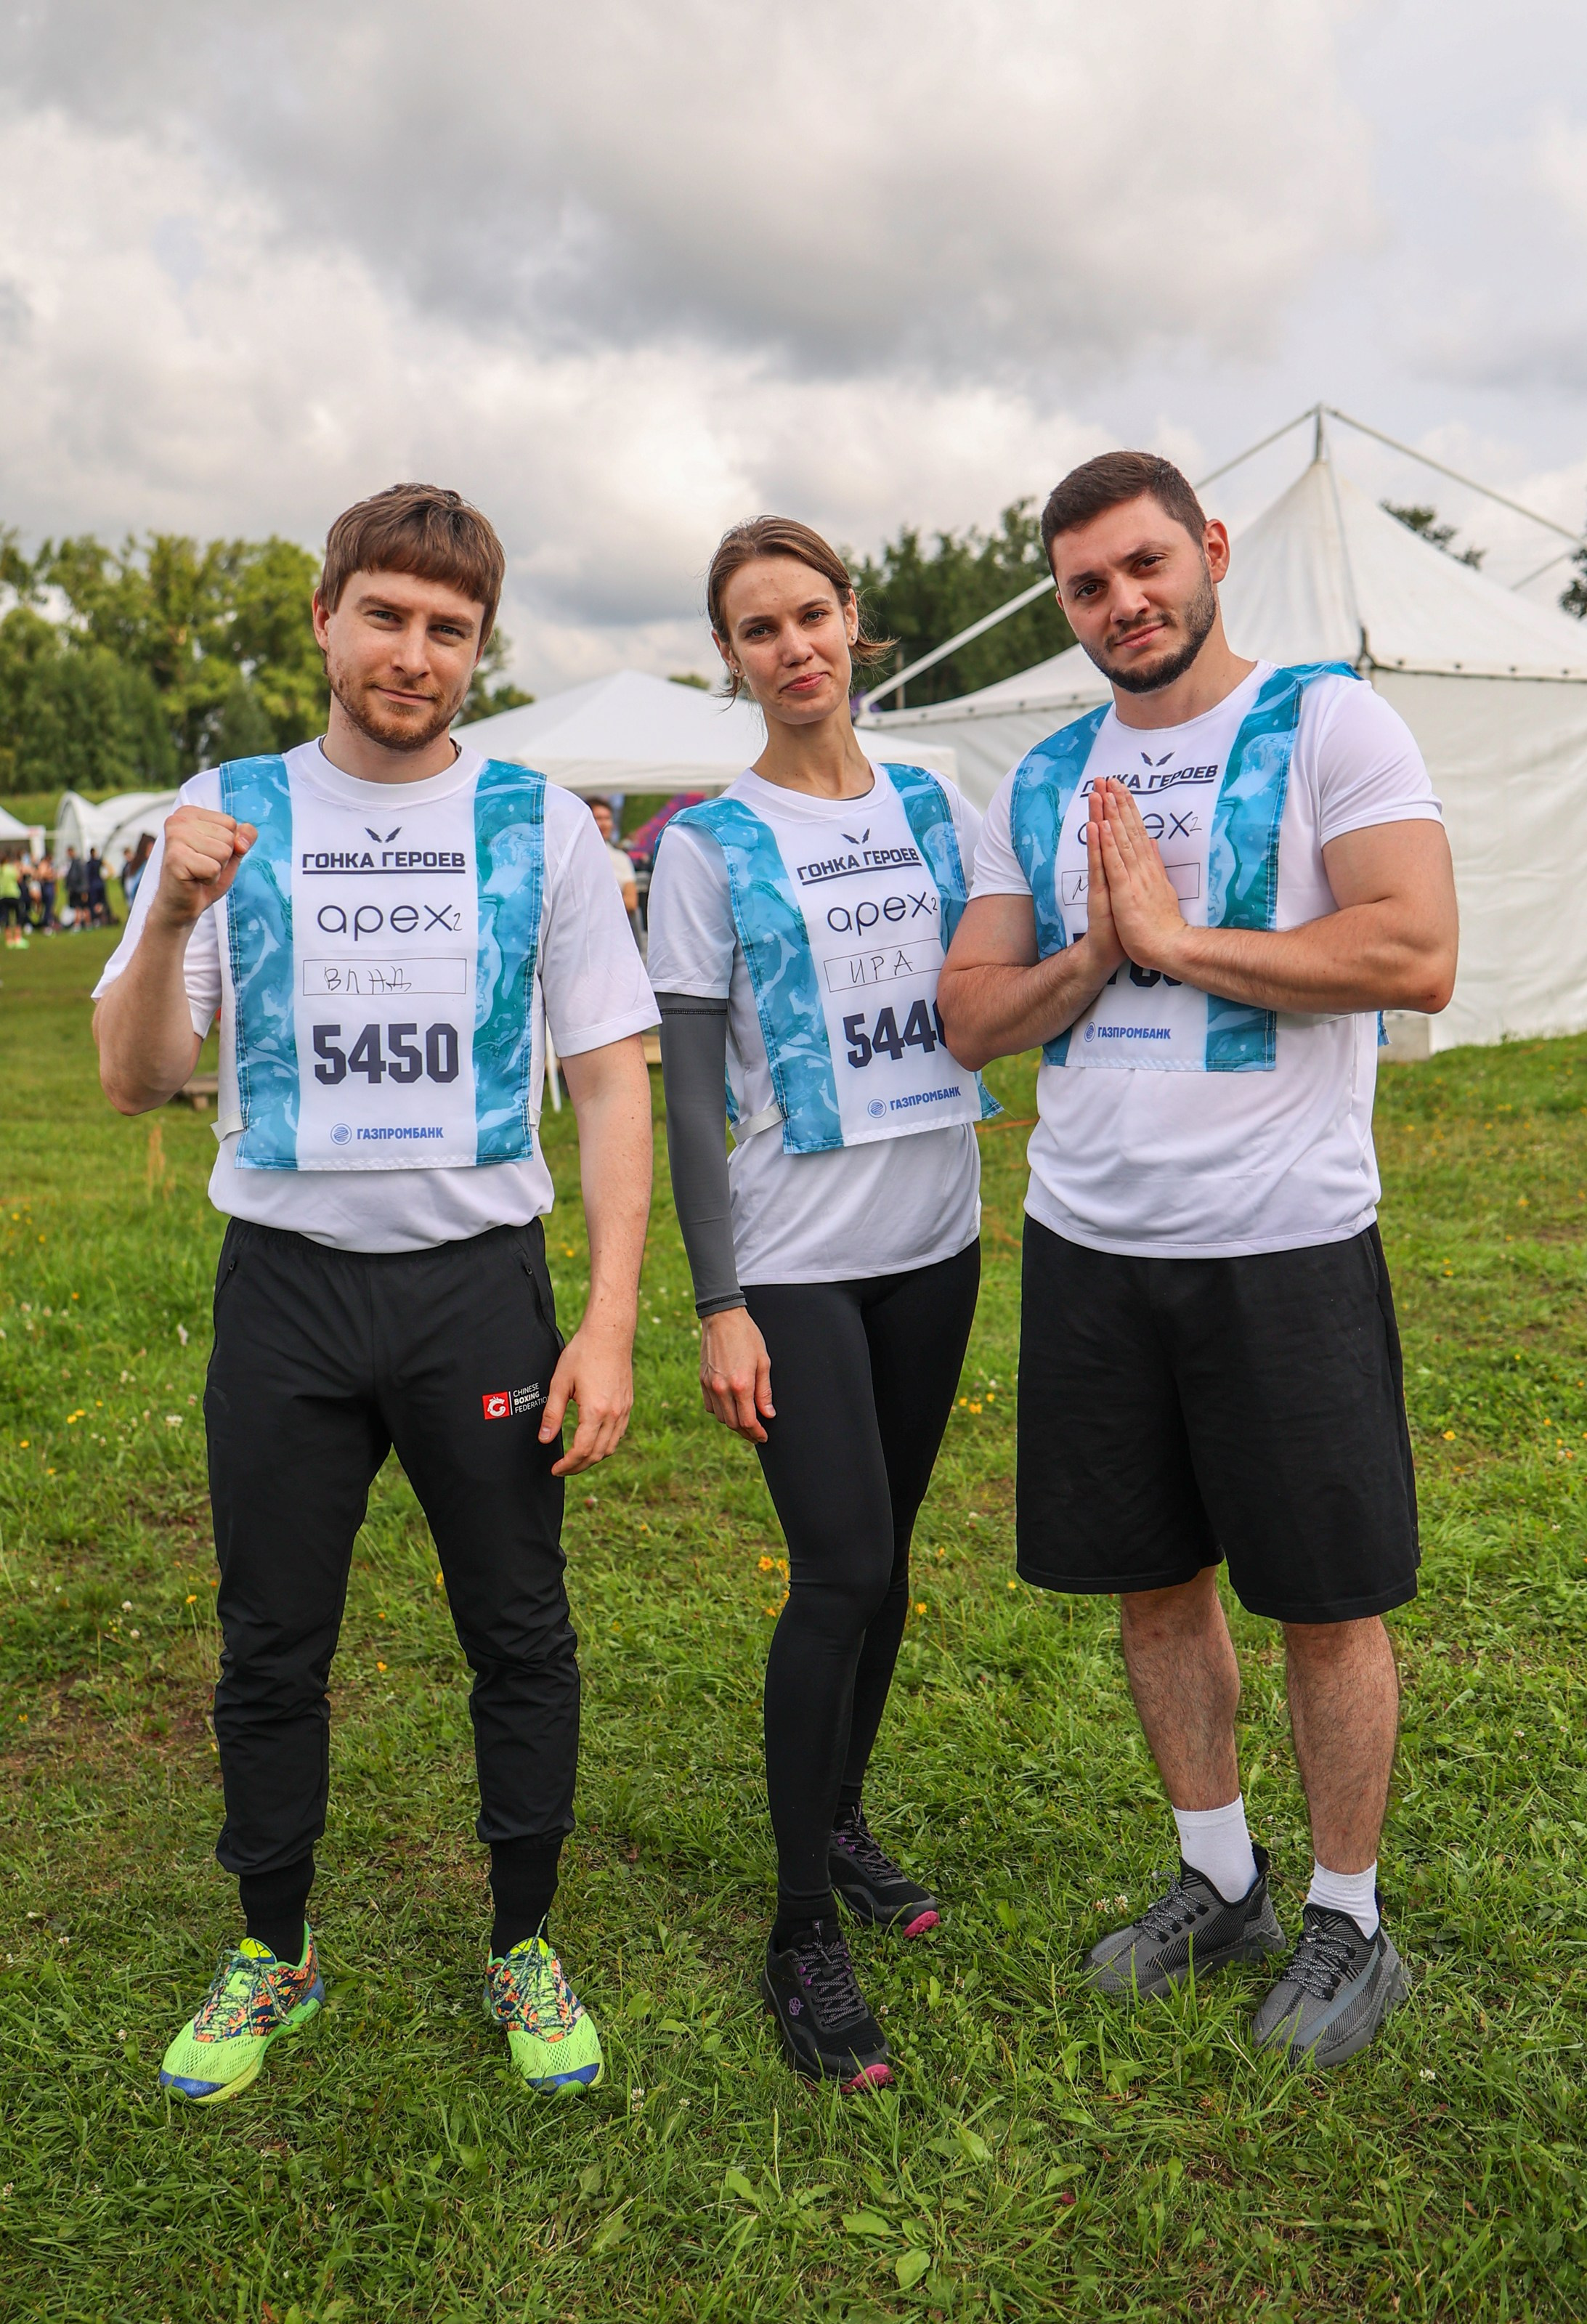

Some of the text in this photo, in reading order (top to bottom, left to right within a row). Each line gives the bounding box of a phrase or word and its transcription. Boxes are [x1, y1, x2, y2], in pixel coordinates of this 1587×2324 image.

[1148, 764, 1219, 789] ГЕРОЕВ
[302, 851, 466, 869] ГОНКА ГЕРОЕВ
[796, 847, 920, 881] ГОНКА ГЕРОЕВ
[317, 903, 454, 942] apex
[827, 891, 933, 937] apex
[849, 950, 914, 985] ИРА
[1097, 1025, 1172, 1041] ГАЗПРОМБАНК
[312, 1023, 460, 1085] 5450
[889, 1086, 962, 1112] ГАЗПРОМБАНК
[356, 1126, 445, 1141] ГАЗПРОМБАНК
[513, 1382, 540, 1397] CHINESE
[514, 1391, 540, 1406] BOXING
[514, 1395, 549, 1414] FEDERATIO
